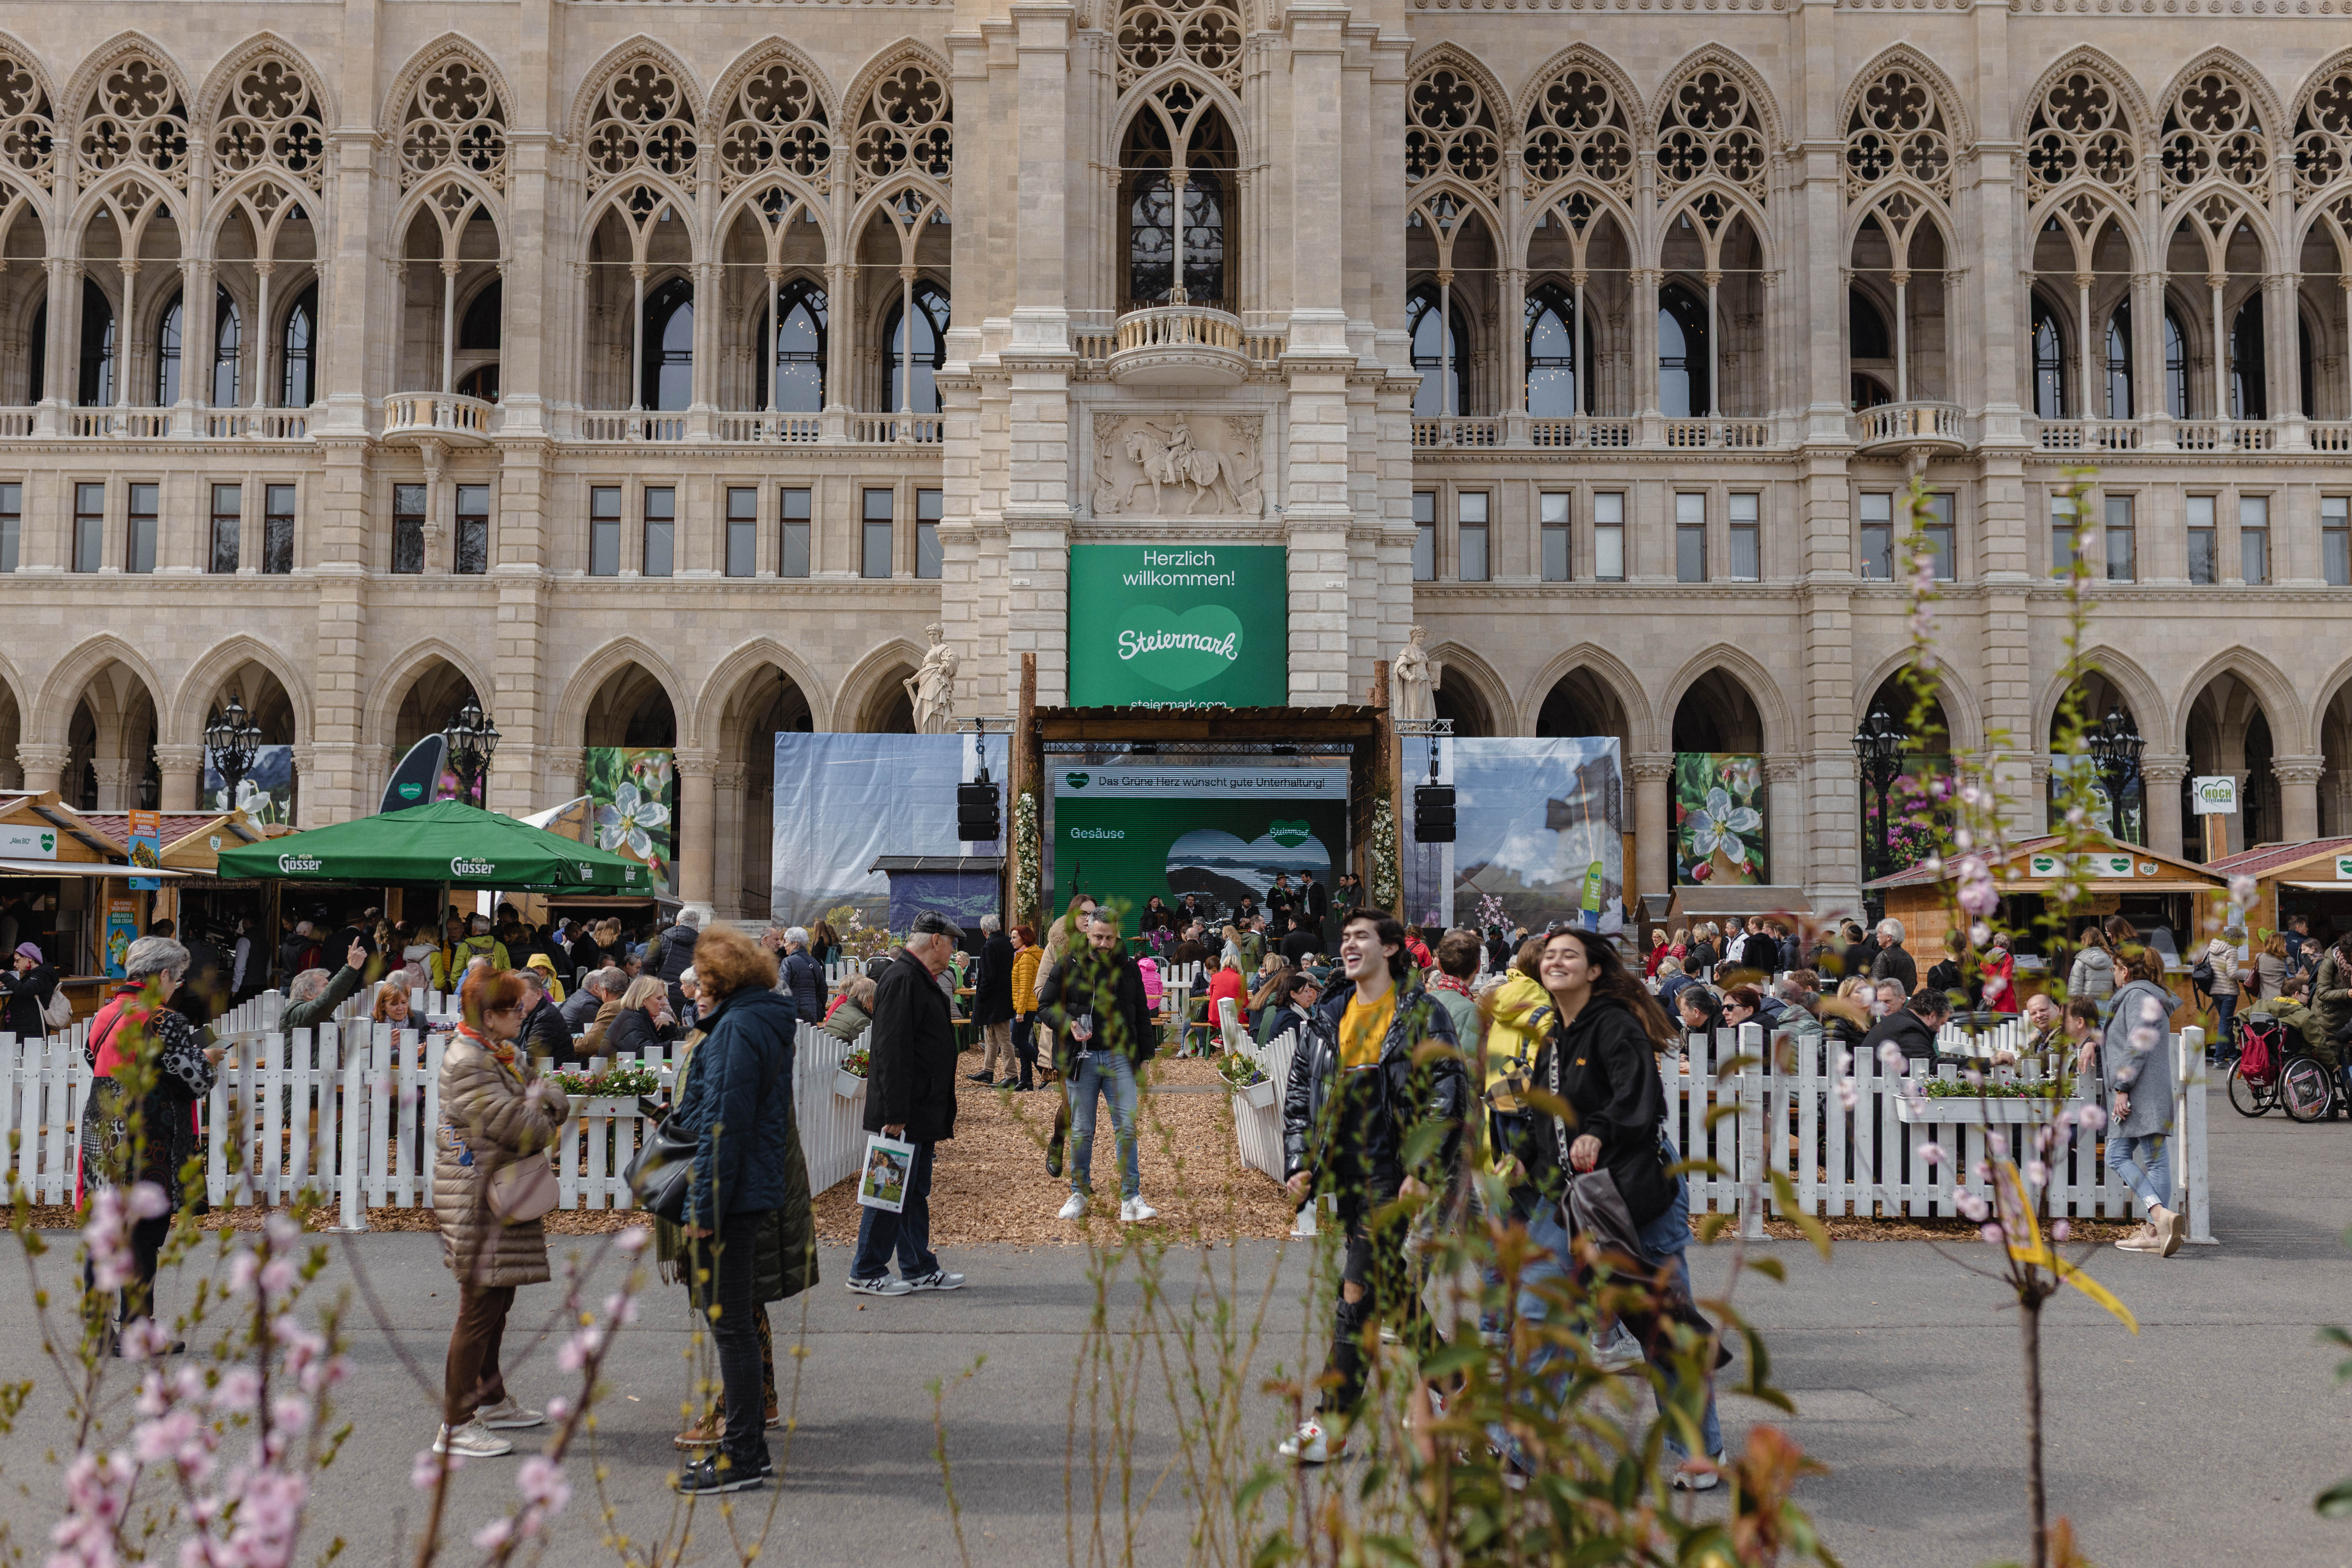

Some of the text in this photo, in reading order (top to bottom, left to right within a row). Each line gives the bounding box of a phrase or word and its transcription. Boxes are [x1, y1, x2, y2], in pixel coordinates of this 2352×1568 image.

[1144, 551, 1215, 565] Herzlich
[1123, 570, 1235, 585] willkommen!
[1118, 630, 1238, 660] Steiermark
[1131, 699, 1227, 709] steiermarkcom
[1099, 777, 1325, 789] Das Grüne Herz wünscht gute Unterhaltung!
[2205, 789, 2231, 798] HOCH
[1071, 828, 1125, 838] Gesäuse
[278, 854, 322, 873] Gösser
[451, 857, 495, 877] Gösser
